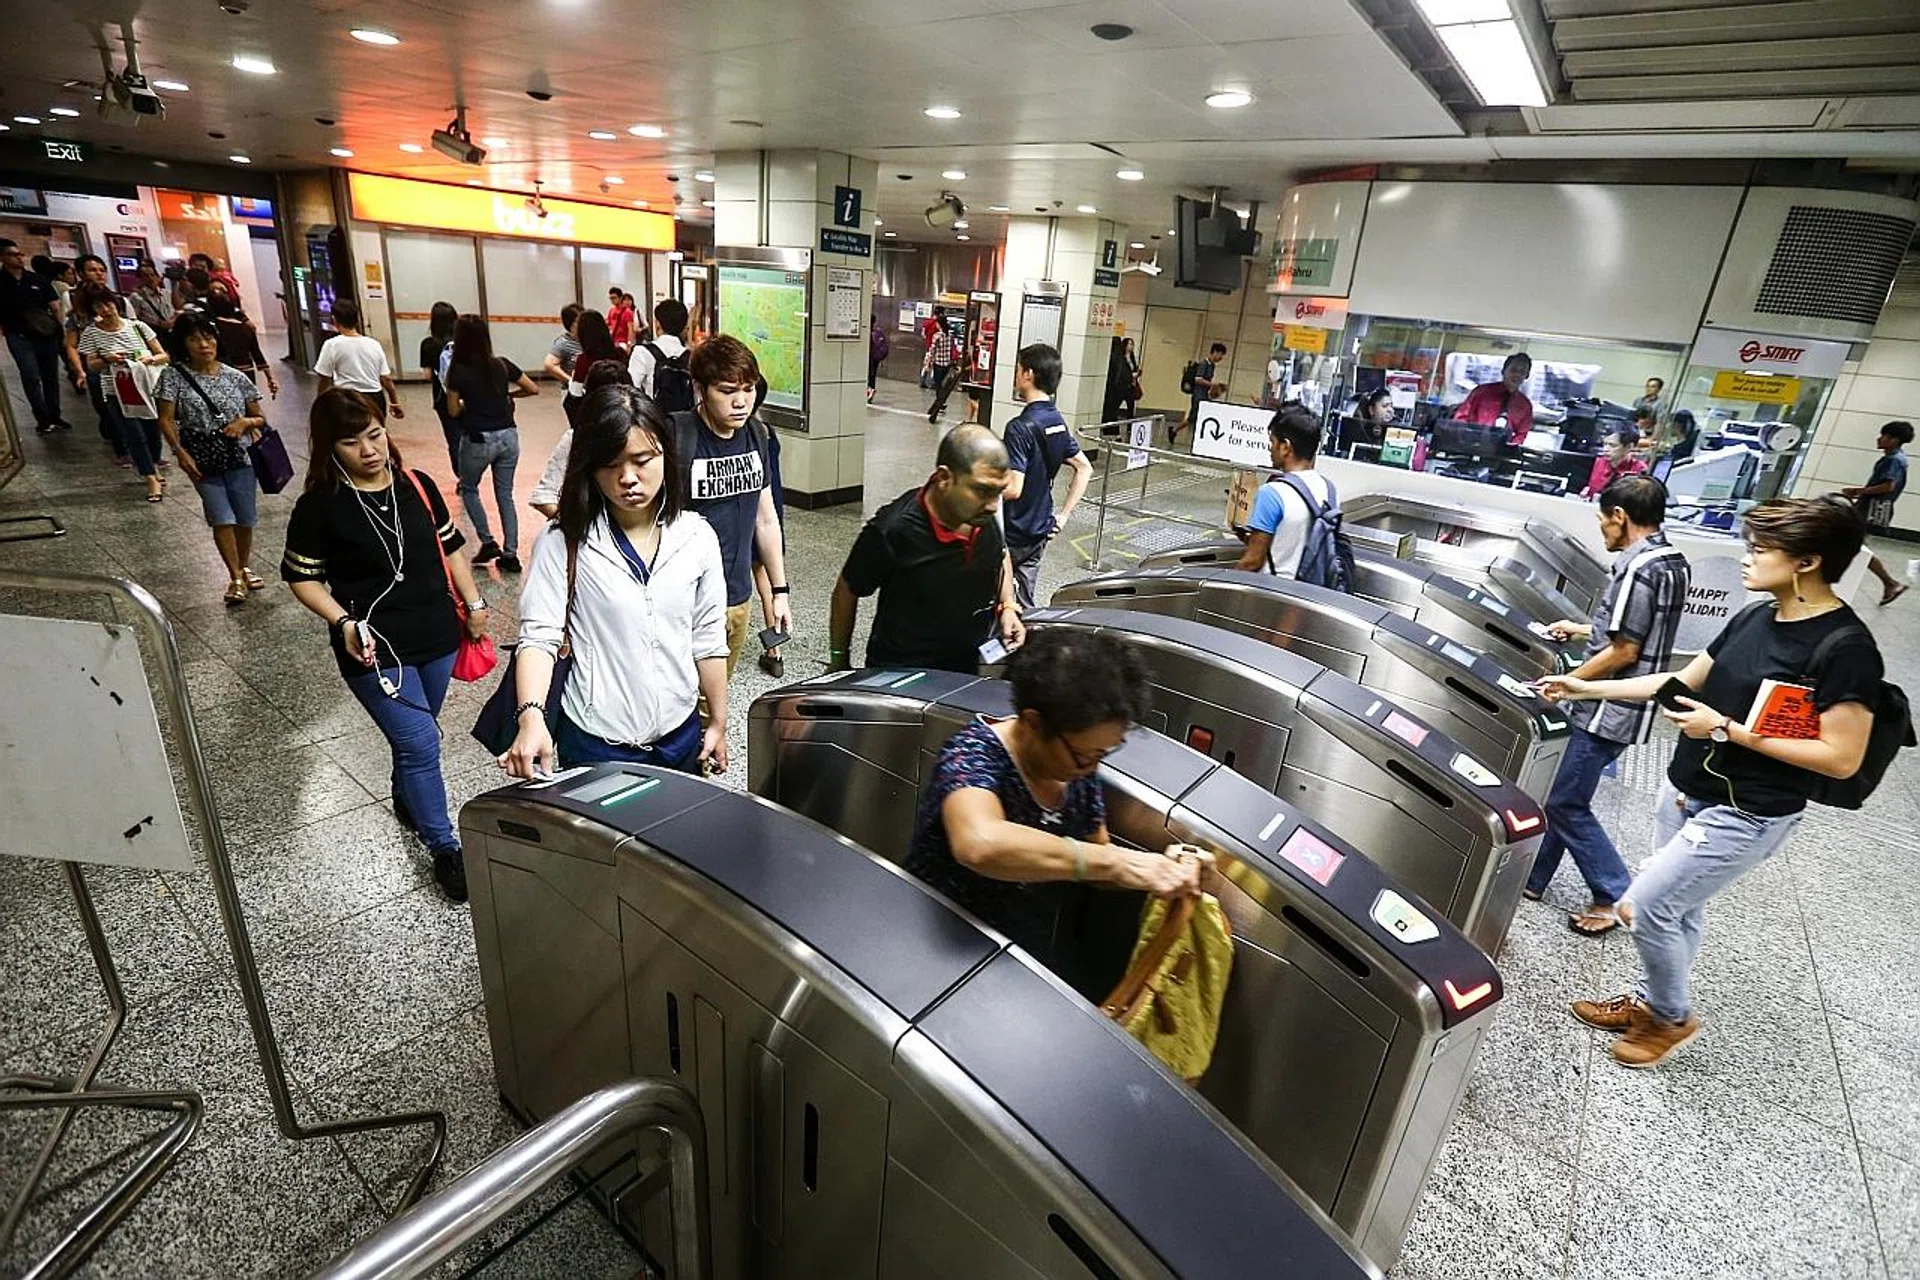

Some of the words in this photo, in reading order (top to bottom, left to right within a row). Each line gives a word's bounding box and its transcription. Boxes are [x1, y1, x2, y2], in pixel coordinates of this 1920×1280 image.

[45, 142, 84, 161] Exit
[492, 194, 576, 238] buzz
[1760, 346, 1806, 361] SMRT
[1231, 420, 1264, 434] Please
[1228, 434, 1242, 445] for
[707, 455, 753, 478] ARMANI
[1687, 586, 1729, 601] HAPPY
[1683, 602, 1729, 617] OLIDAYS
